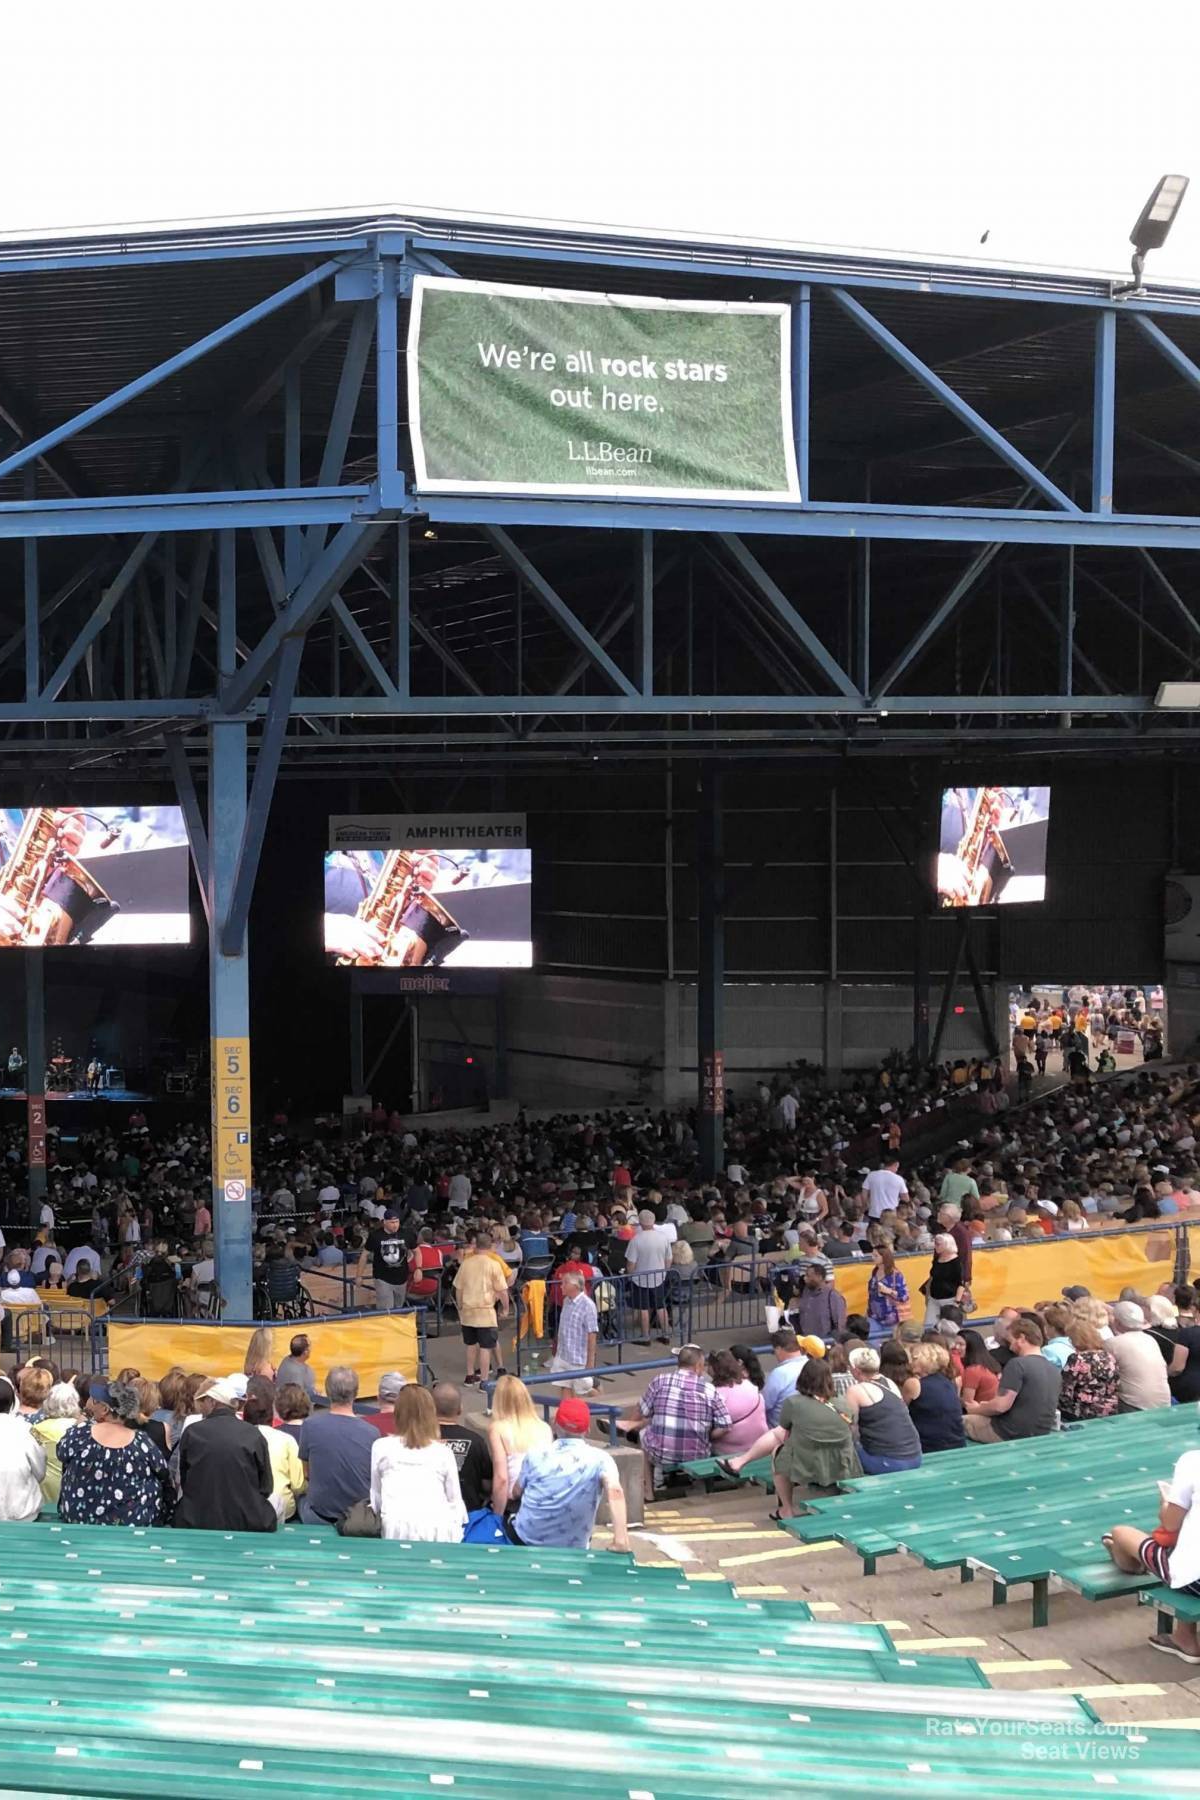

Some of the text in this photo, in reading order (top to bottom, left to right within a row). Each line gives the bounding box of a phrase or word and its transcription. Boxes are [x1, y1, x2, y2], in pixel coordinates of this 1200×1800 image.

[478, 342, 728, 383] We're all rock stars
[550, 385, 664, 413] out here.
[568, 441, 652, 463] L.L.Bean
[406, 826, 522, 839] AMPHITHEATER
[400, 973, 450, 994] meijer
[224, 1047, 242, 1055] SEC
[227, 1056, 240, 1074] 5
[225, 1086, 242, 1094] SEC
[228, 1096, 240, 1114] 6
[33, 1112, 42, 1124] 2
[239, 1133, 246, 1143] F
